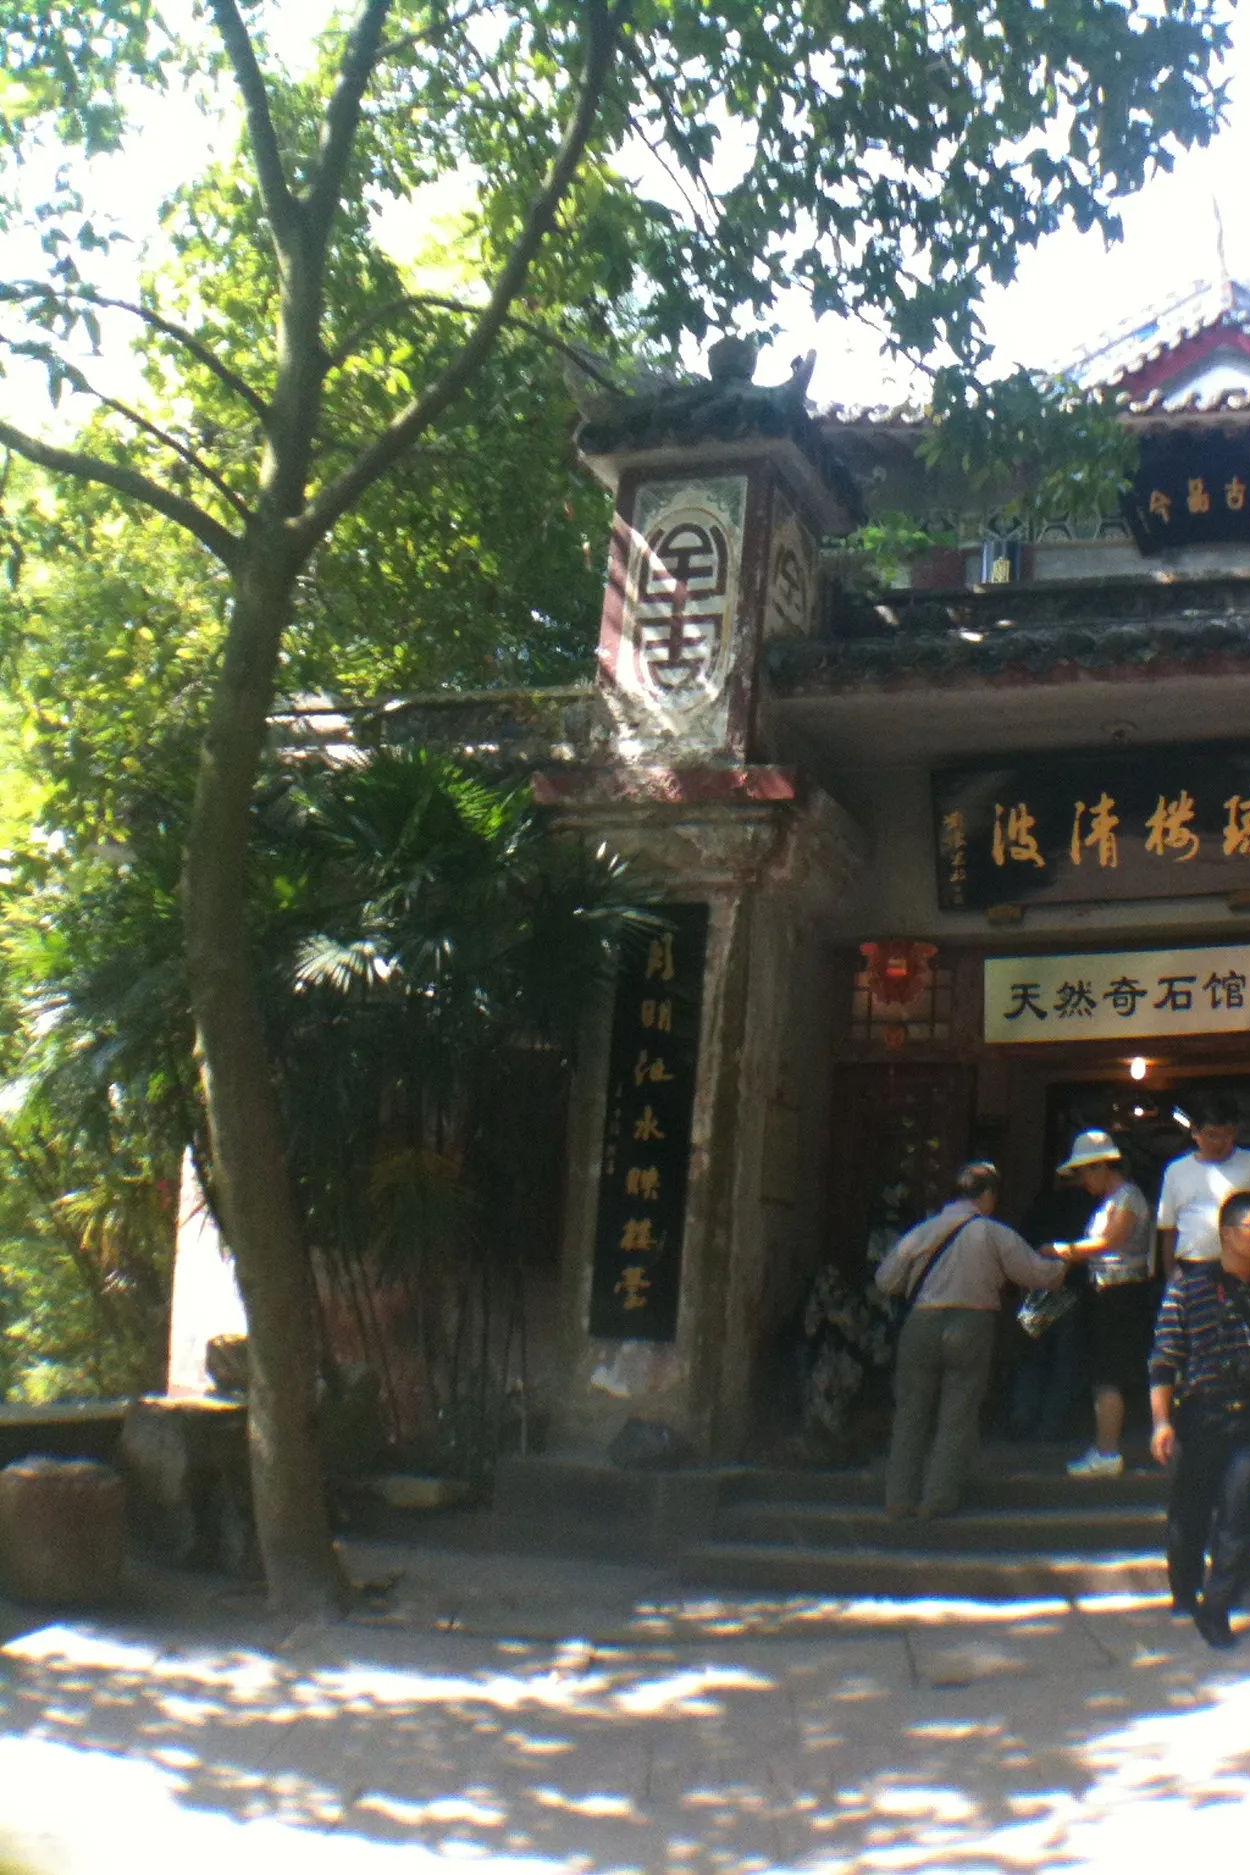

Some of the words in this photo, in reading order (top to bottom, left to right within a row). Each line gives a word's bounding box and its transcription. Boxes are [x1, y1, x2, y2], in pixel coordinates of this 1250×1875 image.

[1003, 969, 1247, 1021] 天然奇石馆
